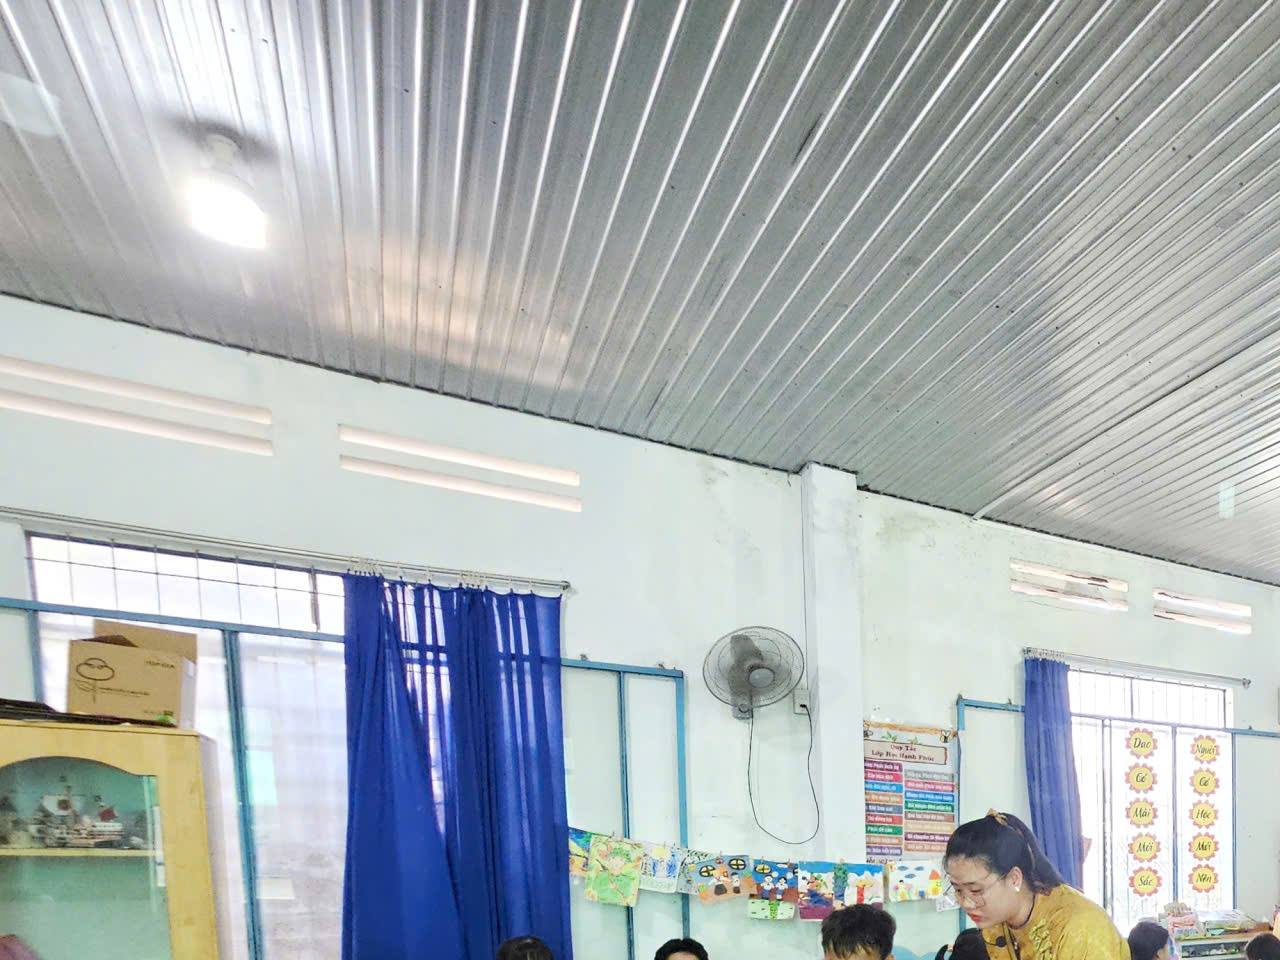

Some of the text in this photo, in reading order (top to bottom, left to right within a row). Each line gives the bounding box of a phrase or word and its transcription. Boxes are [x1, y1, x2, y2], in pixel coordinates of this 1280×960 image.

[1133, 738, 1151, 749] Dao
[1196, 743, 1216, 757] Người
[1136, 842, 1154, 853] Mới
[1138, 875, 1153, 886] Sắc
[1197, 872, 1212, 883] Nên
